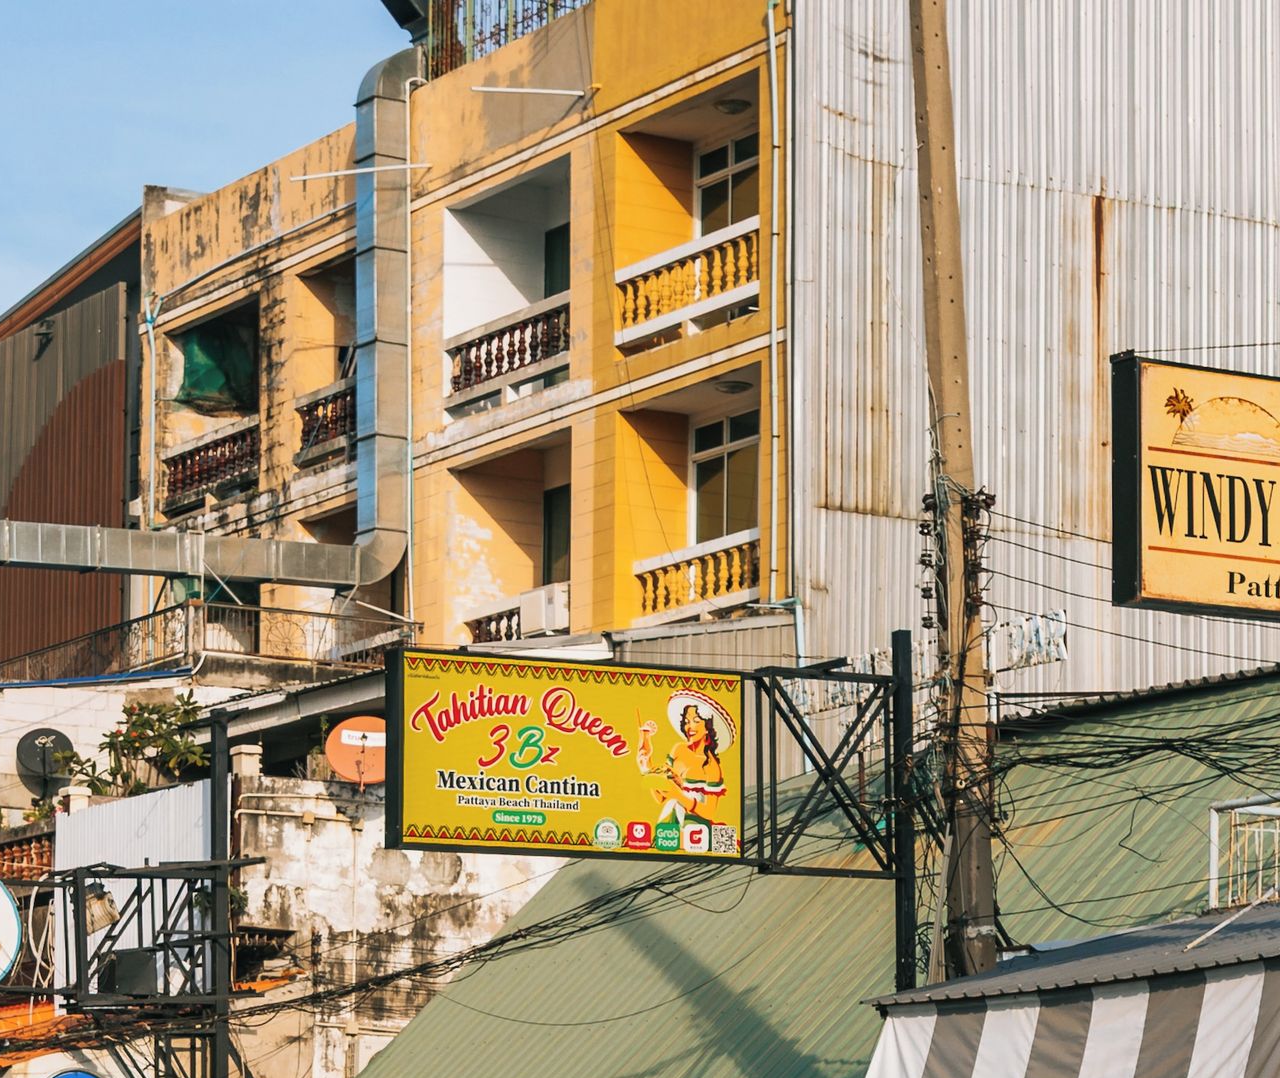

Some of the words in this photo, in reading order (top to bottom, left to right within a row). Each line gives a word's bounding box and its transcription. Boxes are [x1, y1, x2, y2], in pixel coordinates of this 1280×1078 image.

[1147, 465, 1276, 547] WINDY
[411, 684, 531, 743] Tahitian
[541, 686, 631, 758] Queen
[437, 770, 521, 794] Mexican
[524, 774, 601, 798] Cantina
[457, 795, 497, 809] Pattaya
[498, 796, 531, 808] Beach
[532, 798, 580, 811] Thailand
[494, 812, 519, 823] Since
[520, 813, 544, 824] 1978
[657, 828, 680, 838] Grab
[658, 838, 678, 847] Food
